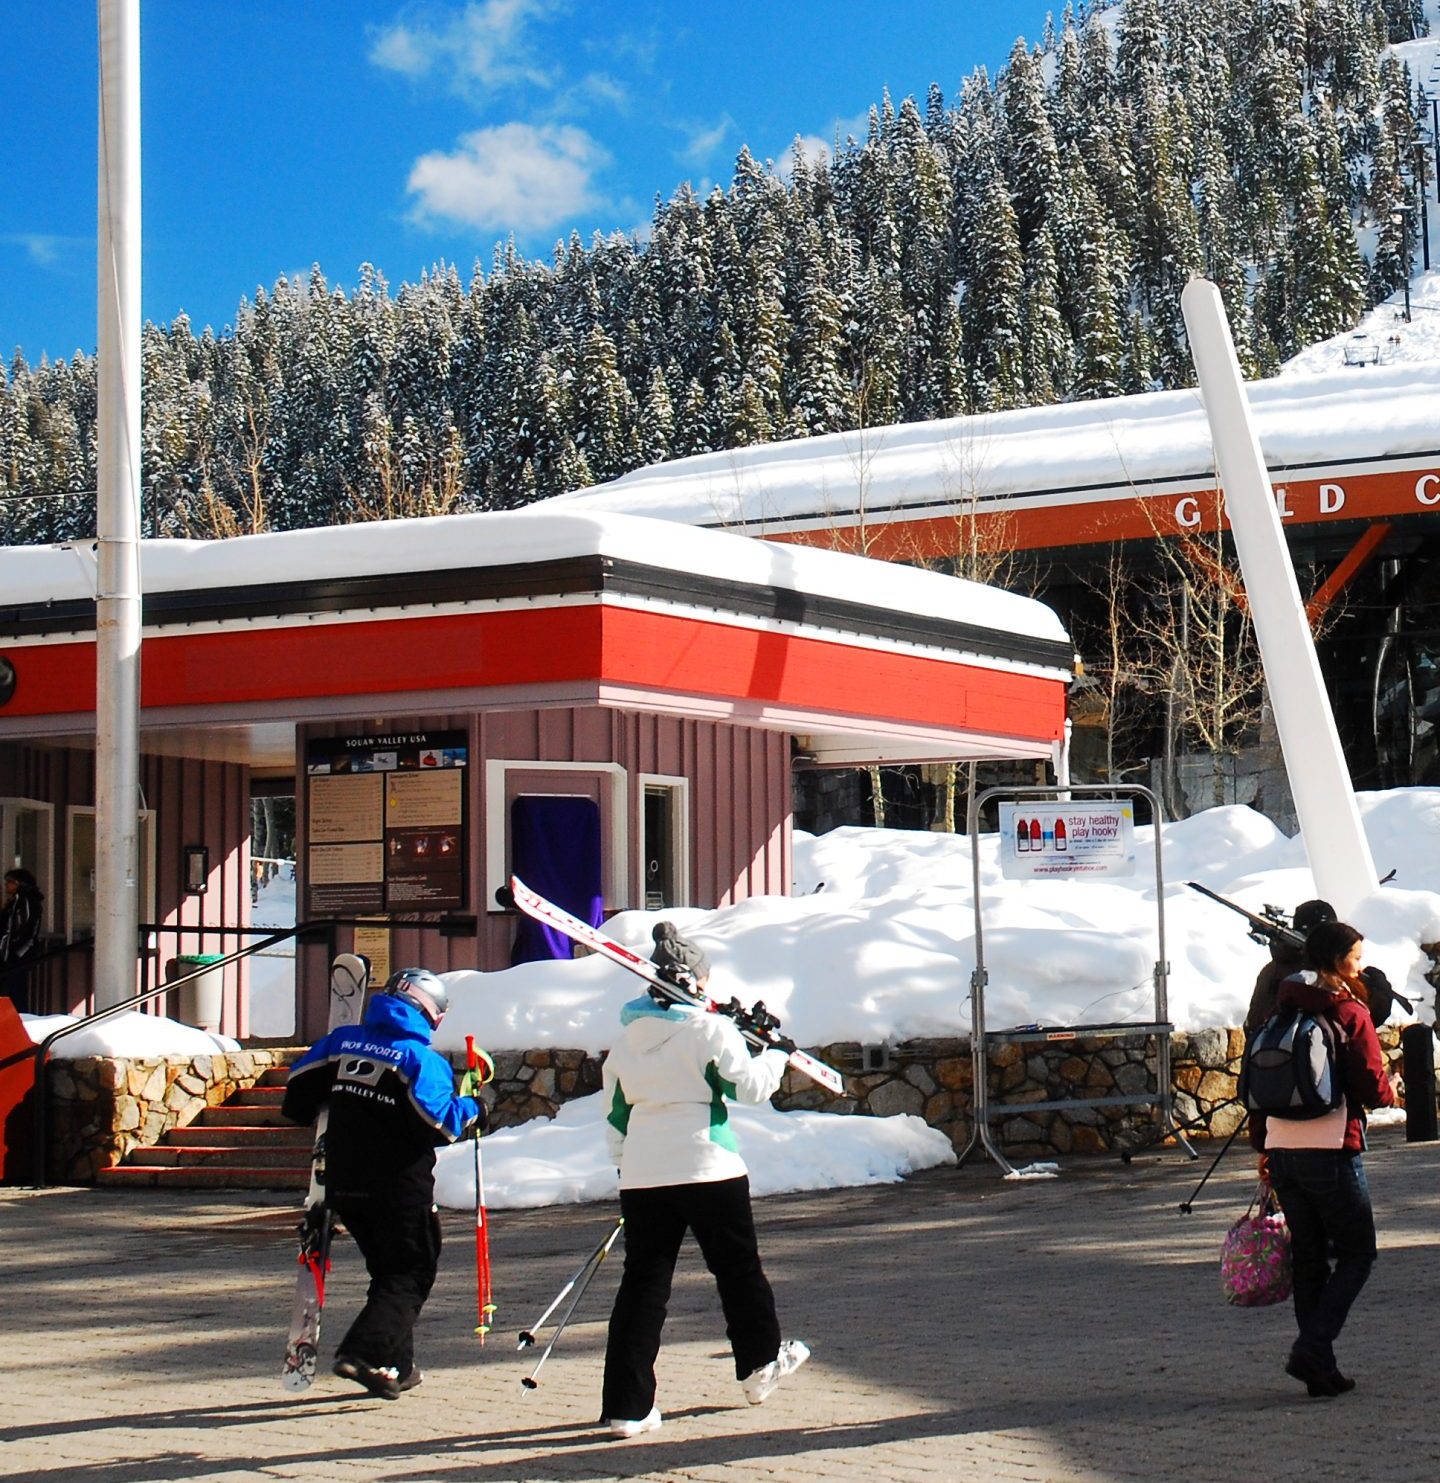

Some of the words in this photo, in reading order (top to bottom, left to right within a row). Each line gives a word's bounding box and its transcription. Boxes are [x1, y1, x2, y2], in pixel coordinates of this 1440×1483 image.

[1175, 483, 1346, 527] GLD
[345, 738, 374, 747] SQUAW
[377, 736, 407, 745] VALLEY
[410, 735, 427, 743] USA
[1068, 816, 1086, 827] stay
[1089, 814, 1120, 827] healthy
[1072, 827, 1089, 839] play
[1092, 826, 1118, 838] hooky
[363, 1042, 404, 1060] SPORTS
[376, 1093, 396, 1106] USA
